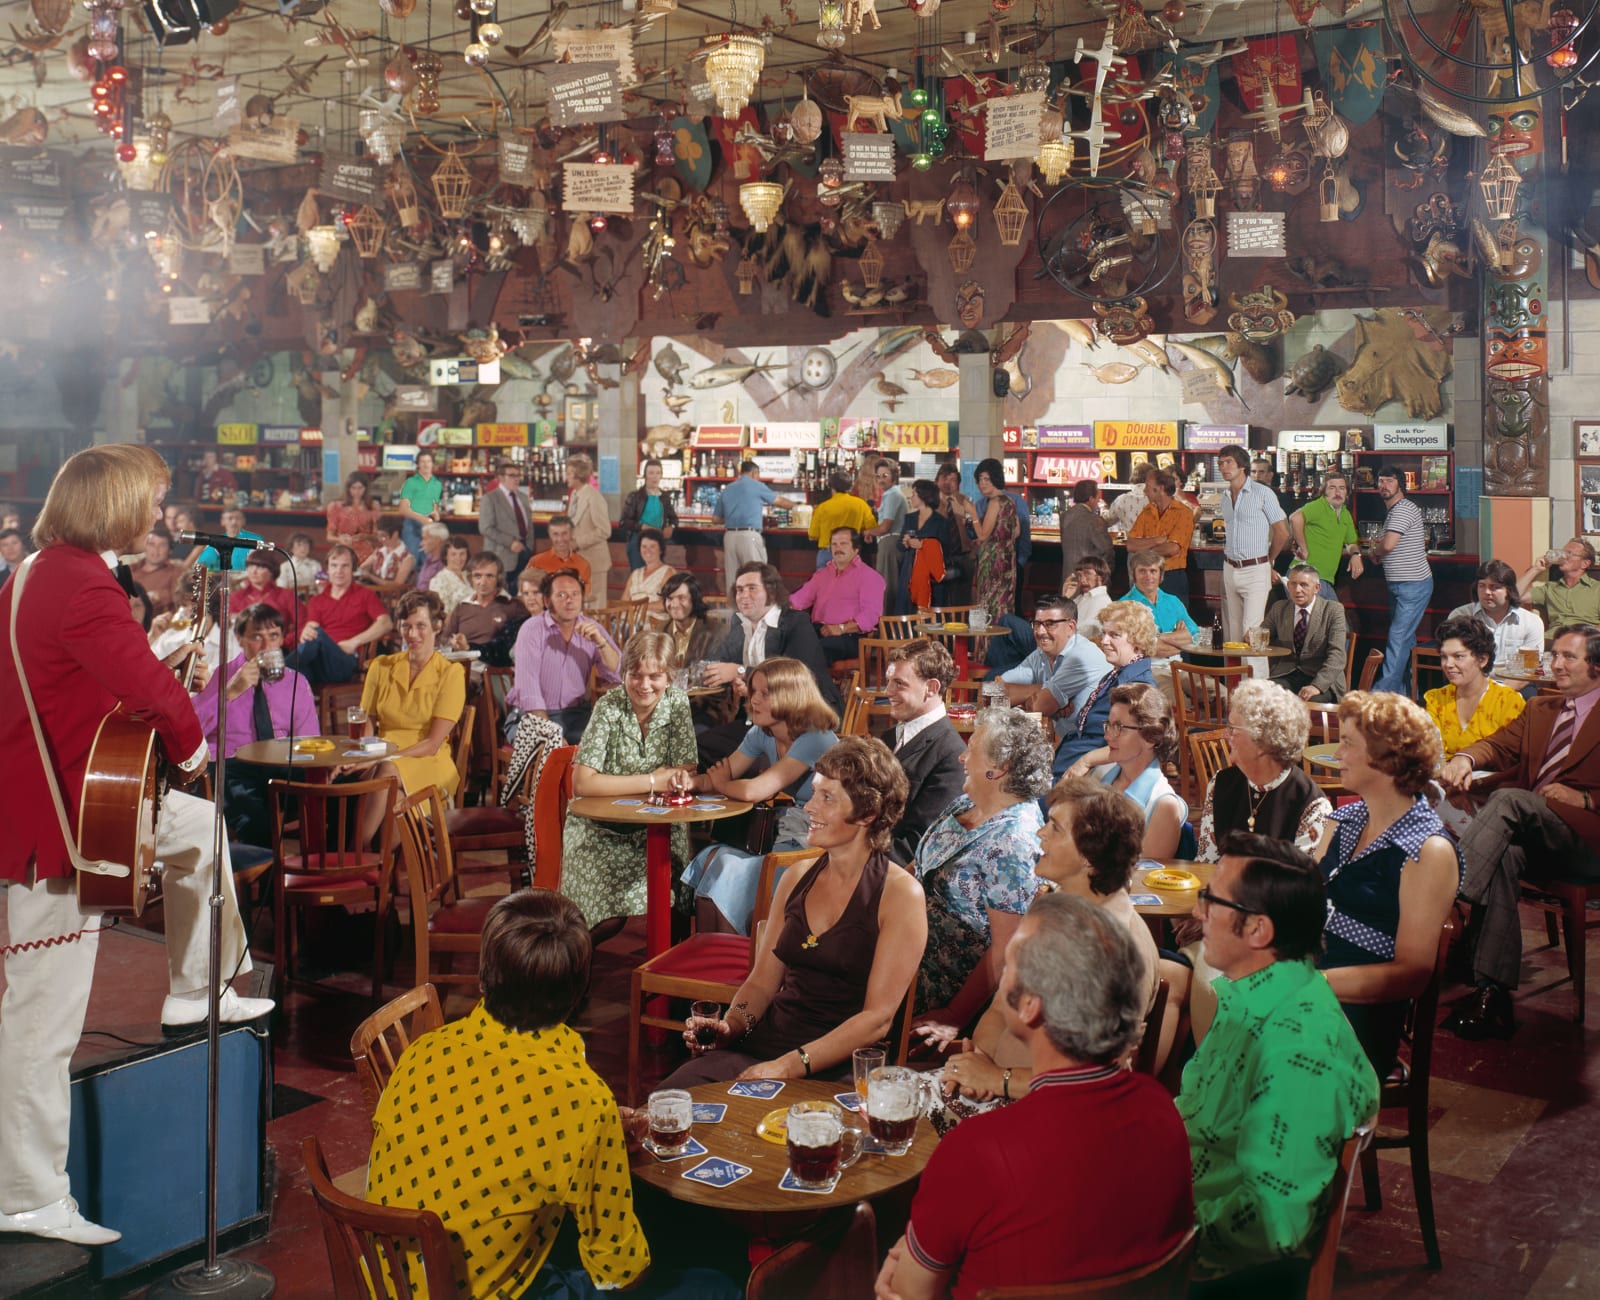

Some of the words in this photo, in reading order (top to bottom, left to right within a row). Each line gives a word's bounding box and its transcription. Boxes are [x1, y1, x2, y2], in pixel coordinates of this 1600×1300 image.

[600, 96, 612, 104] SHE
[338, 164, 372, 176] OPTIMIST
[496, 424, 520, 432] DOUBLE
[1126, 423, 1167, 434] DOUBLE
[882, 424, 945, 446] SKOL
[1384, 434, 1438, 446] Schweppes
[1122, 436, 1171, 446] DIAMOND
[1040, 457, 1100, 479] MANNS
